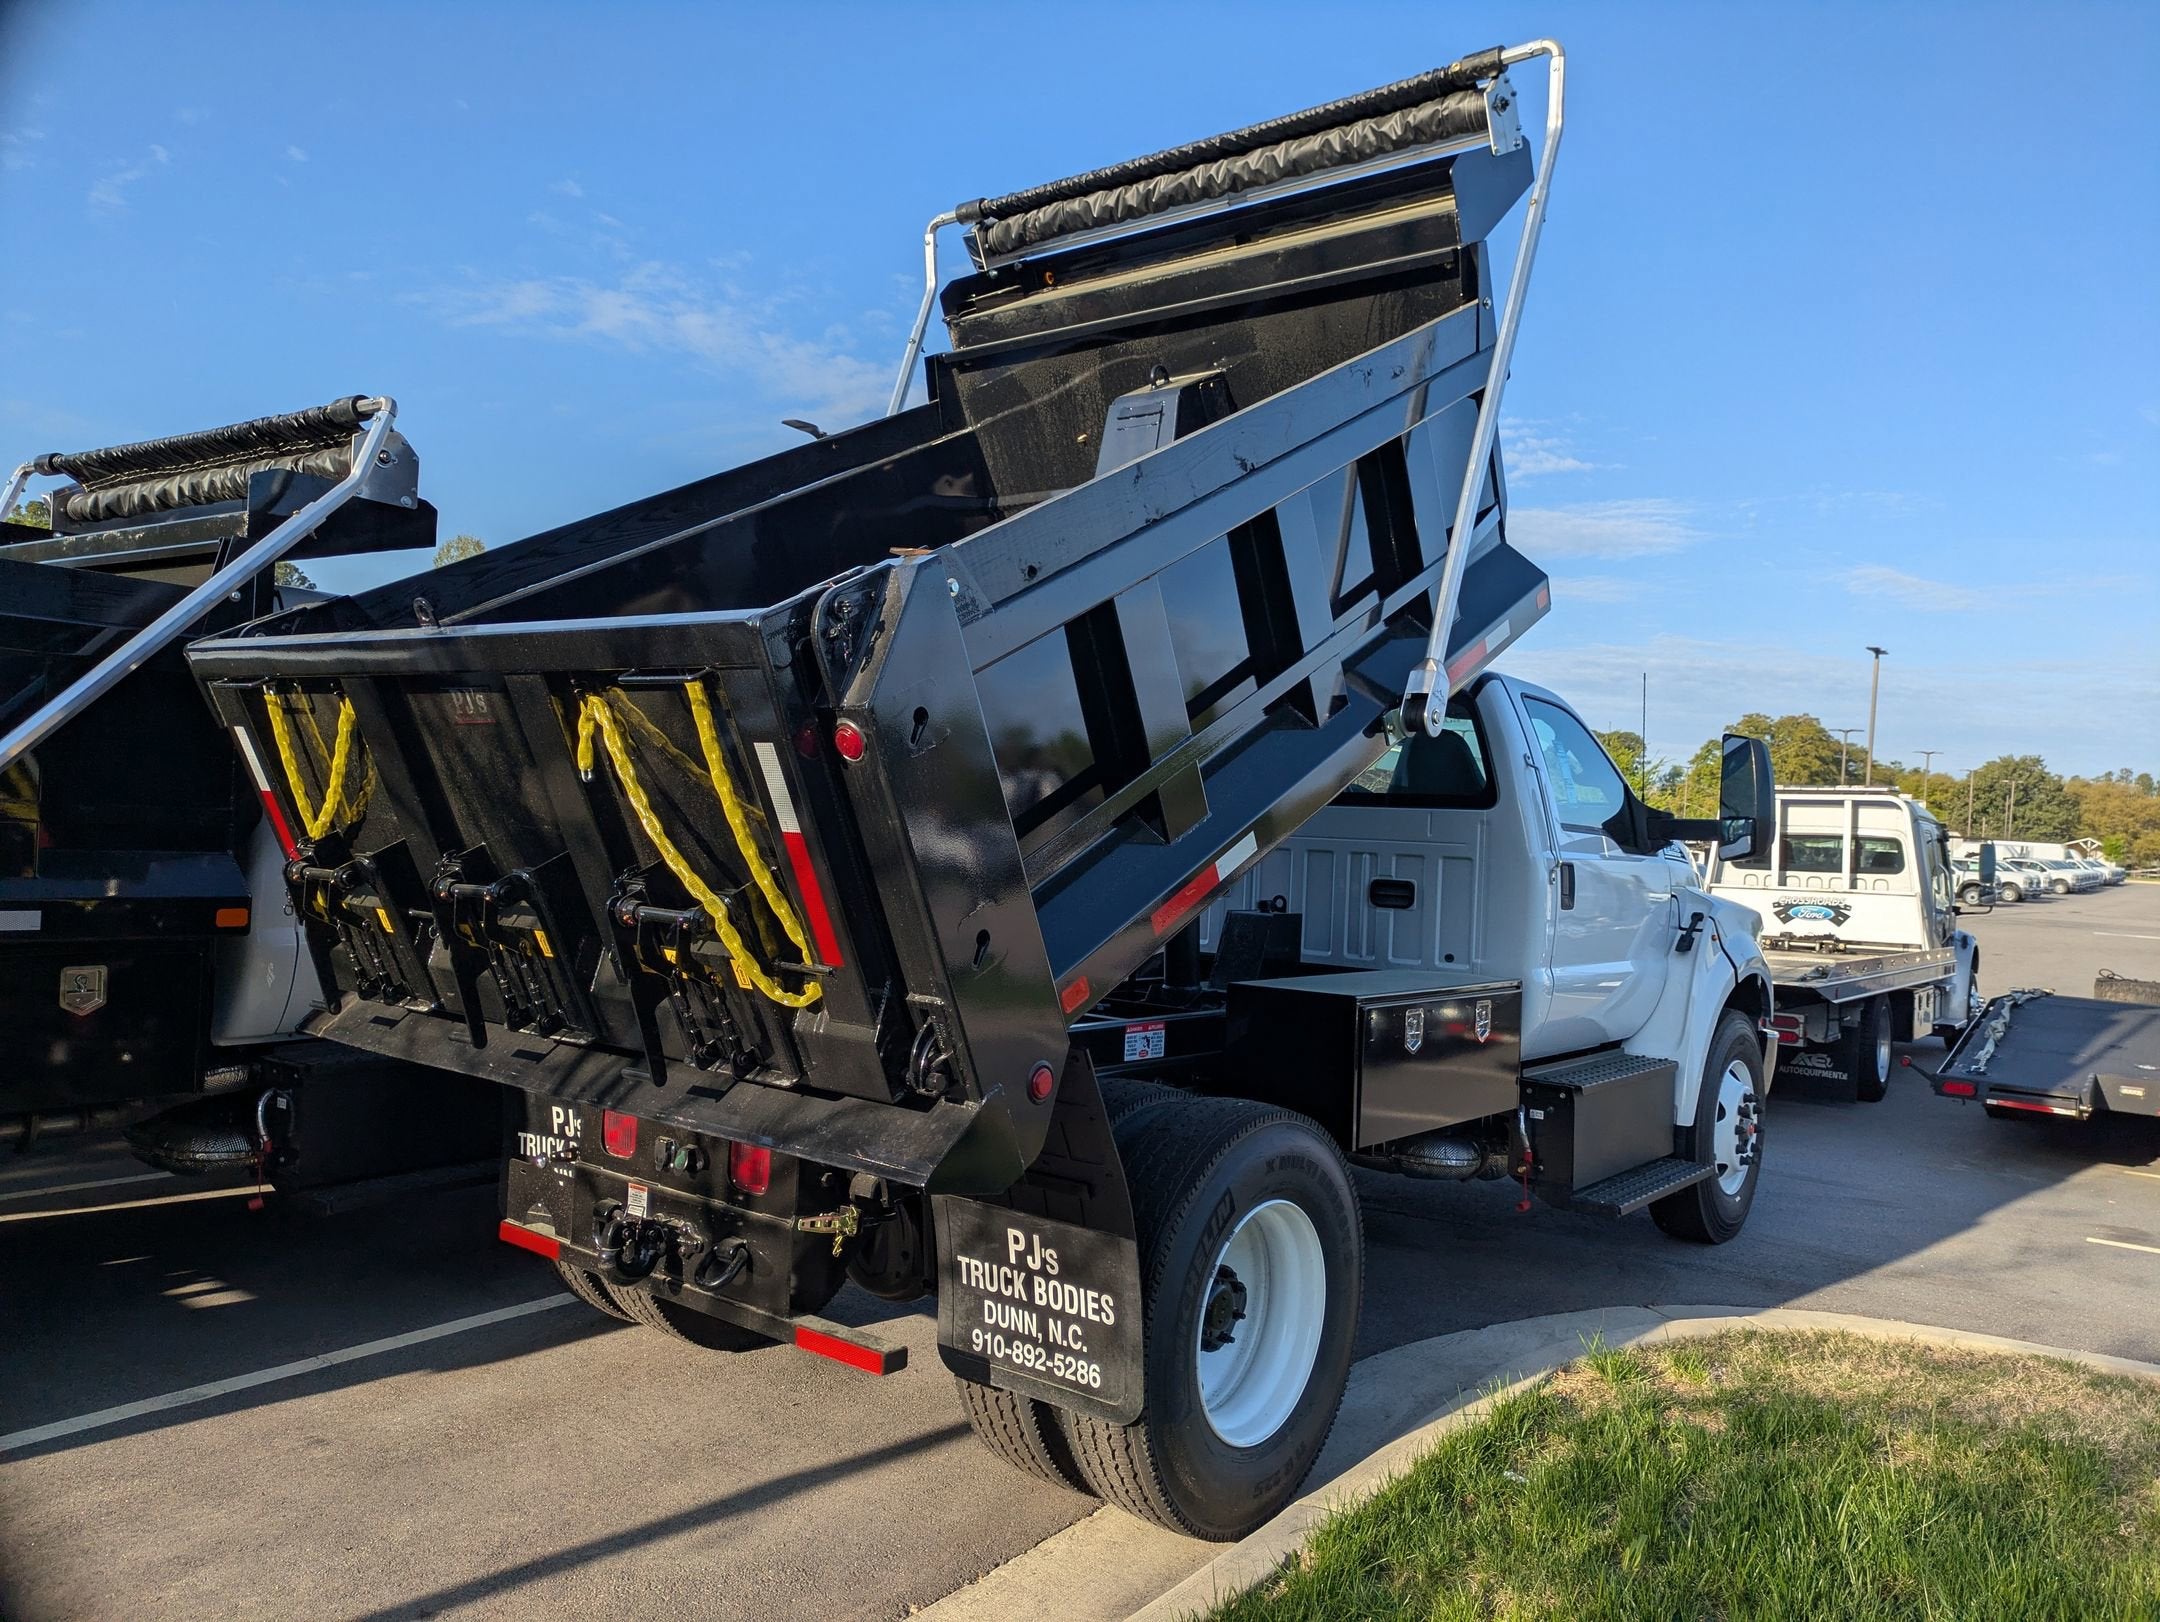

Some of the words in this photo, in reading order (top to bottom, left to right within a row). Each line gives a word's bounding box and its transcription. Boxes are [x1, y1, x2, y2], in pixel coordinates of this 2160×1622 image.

[1779, 894, 1846, 907] CROSSROADS
[1797, 905, 1825, 919] Ford
[956, 1254, 1028, 1303] TRUCK
[1033, 1275, 1116, 1326] BODIES
[983, 1299, 1043, 1344] DUNN,
[1048, 1317, 1089, 1353] N.C.
[971, 1328, 1101, 1389] 910-892-5286
